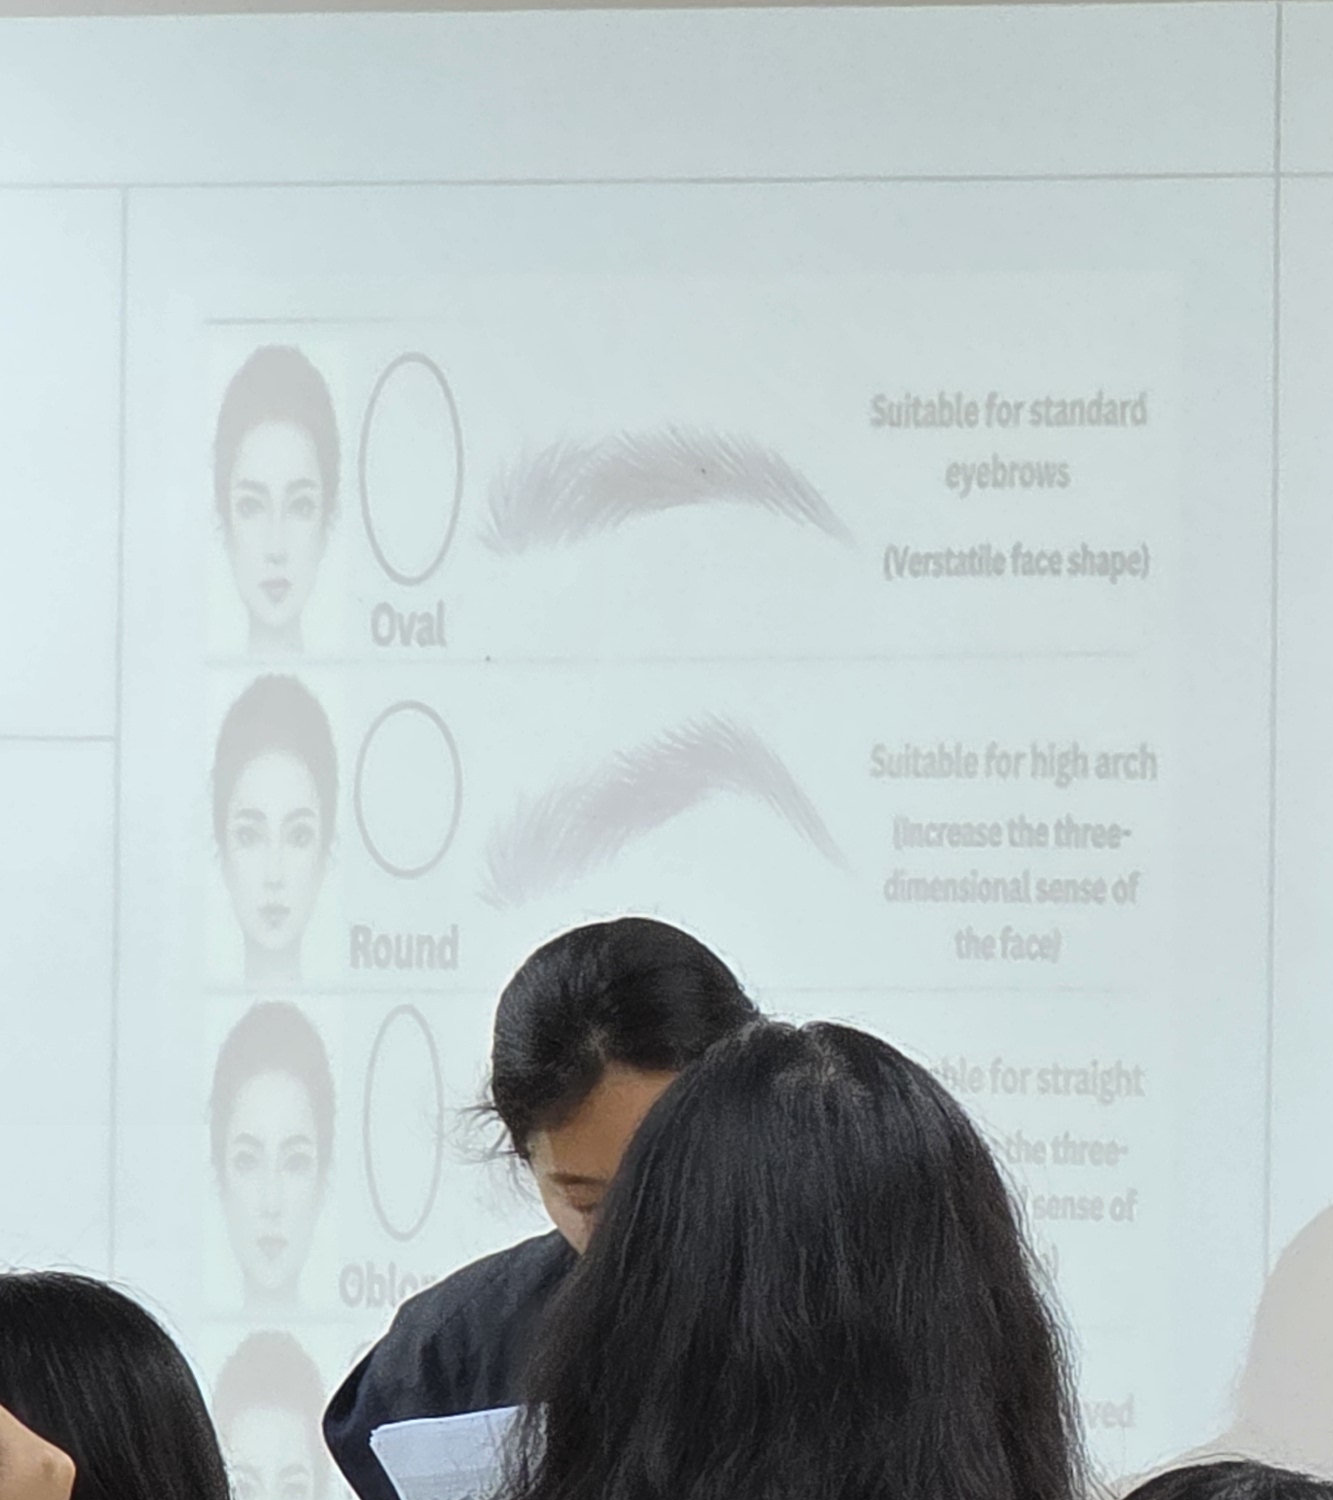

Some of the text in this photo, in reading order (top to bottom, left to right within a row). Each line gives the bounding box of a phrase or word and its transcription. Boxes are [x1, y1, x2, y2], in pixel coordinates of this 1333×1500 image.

[869, 389, 1148, 429] Suitable for standard
[944, 452, 1072, 500] eyebrows
[884, 541, 1151, 585] (Verstatile face shape)
[370, 601, 447, 650] Oval
[869, 740, 1159, 788] Suitable for high arch
[892, 812, 1133, 850] (Increase the three-
[883, 867, 1142, 905] dimensional sense of
[349, 923, 460, 974] Round
[954, 925, 1063, 963] the face)
[989, 1056, 1034, 1096] for
[1036, 1058, 1146, 1105] straight
[1005, 1129, 1129, 1166] the three-
[1032, 1193, 1105, 1222] sense
[1109, 1187, 1139, 1222] of
[338, 1261, 437, 1308] Oblo
